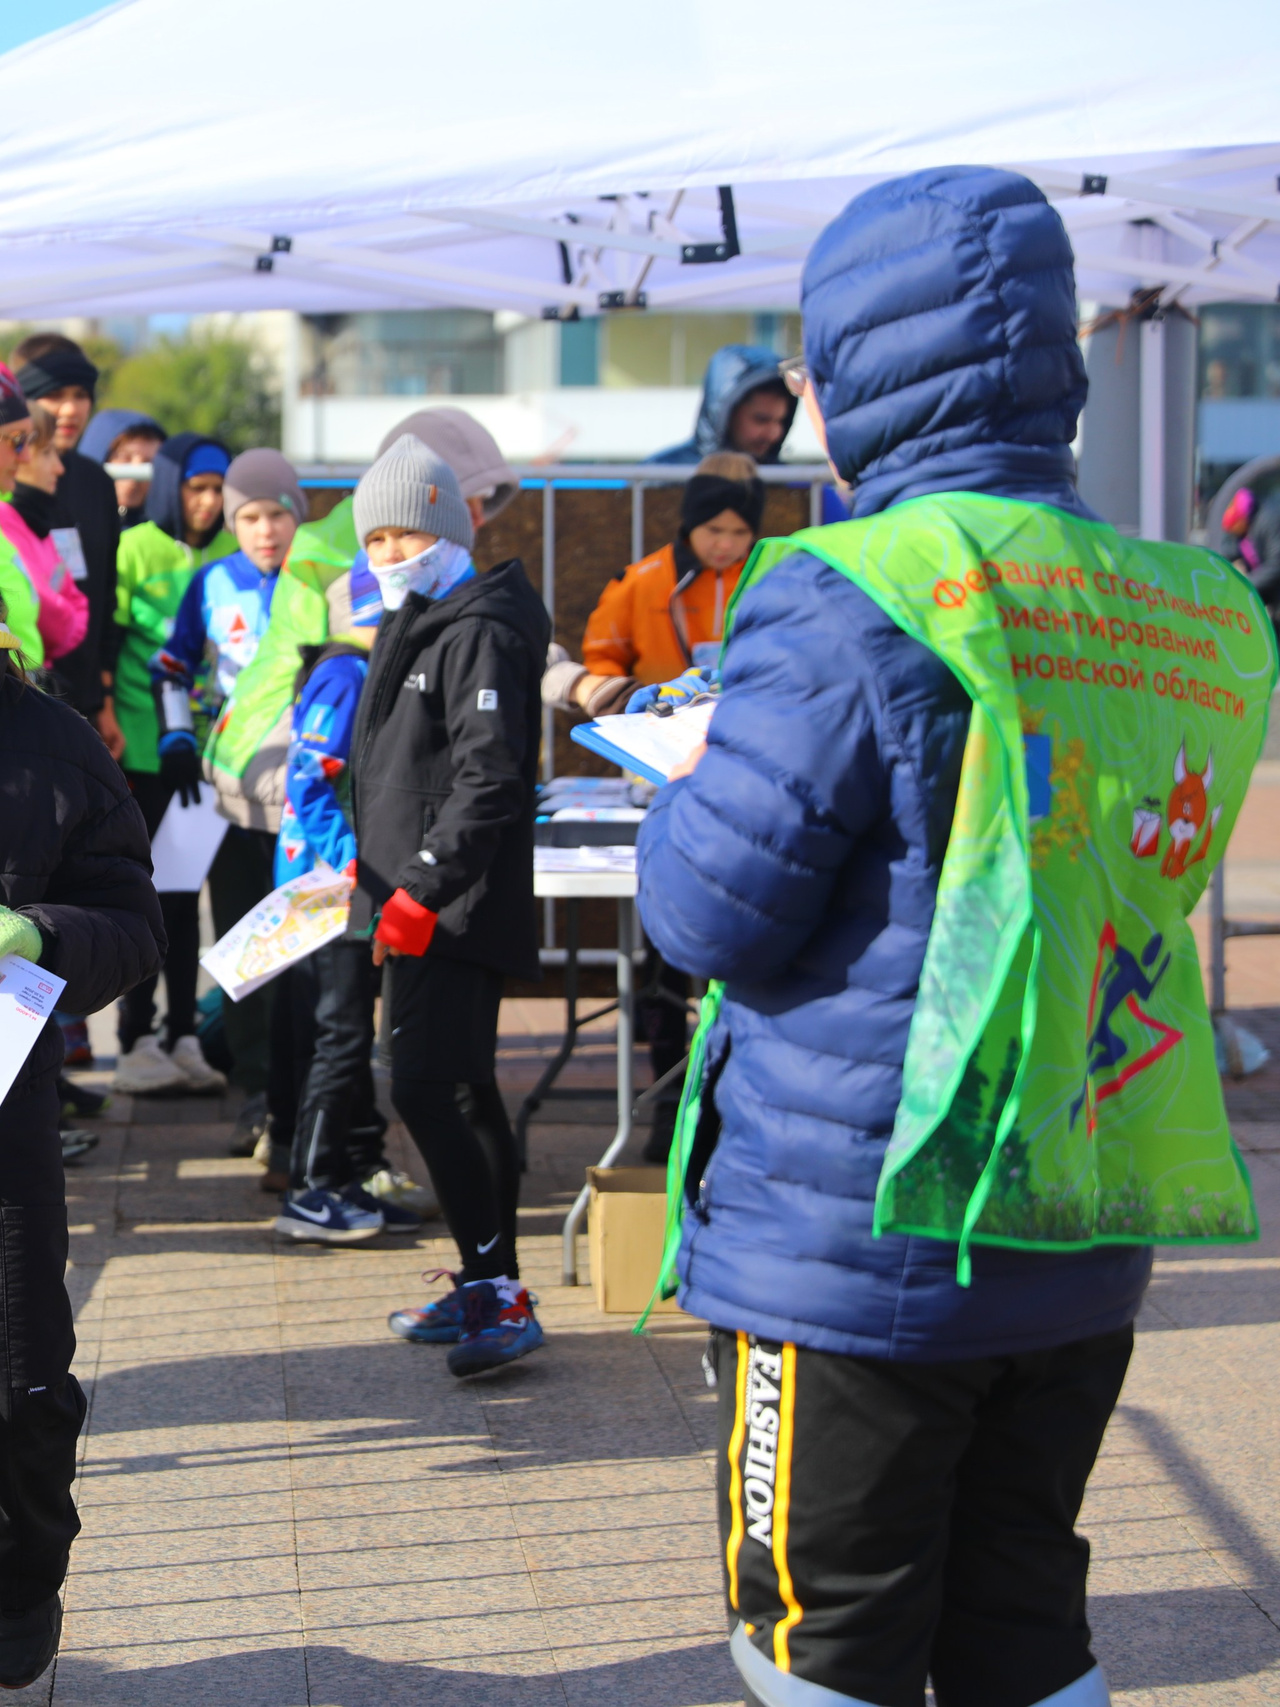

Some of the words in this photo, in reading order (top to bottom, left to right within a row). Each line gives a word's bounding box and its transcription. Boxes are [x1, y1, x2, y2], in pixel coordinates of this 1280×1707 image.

[1093, 571, 1252, 635] спортивного
[1153, 667, 1246, 720] области
[744, 1345, 782, 1549] FASHION
